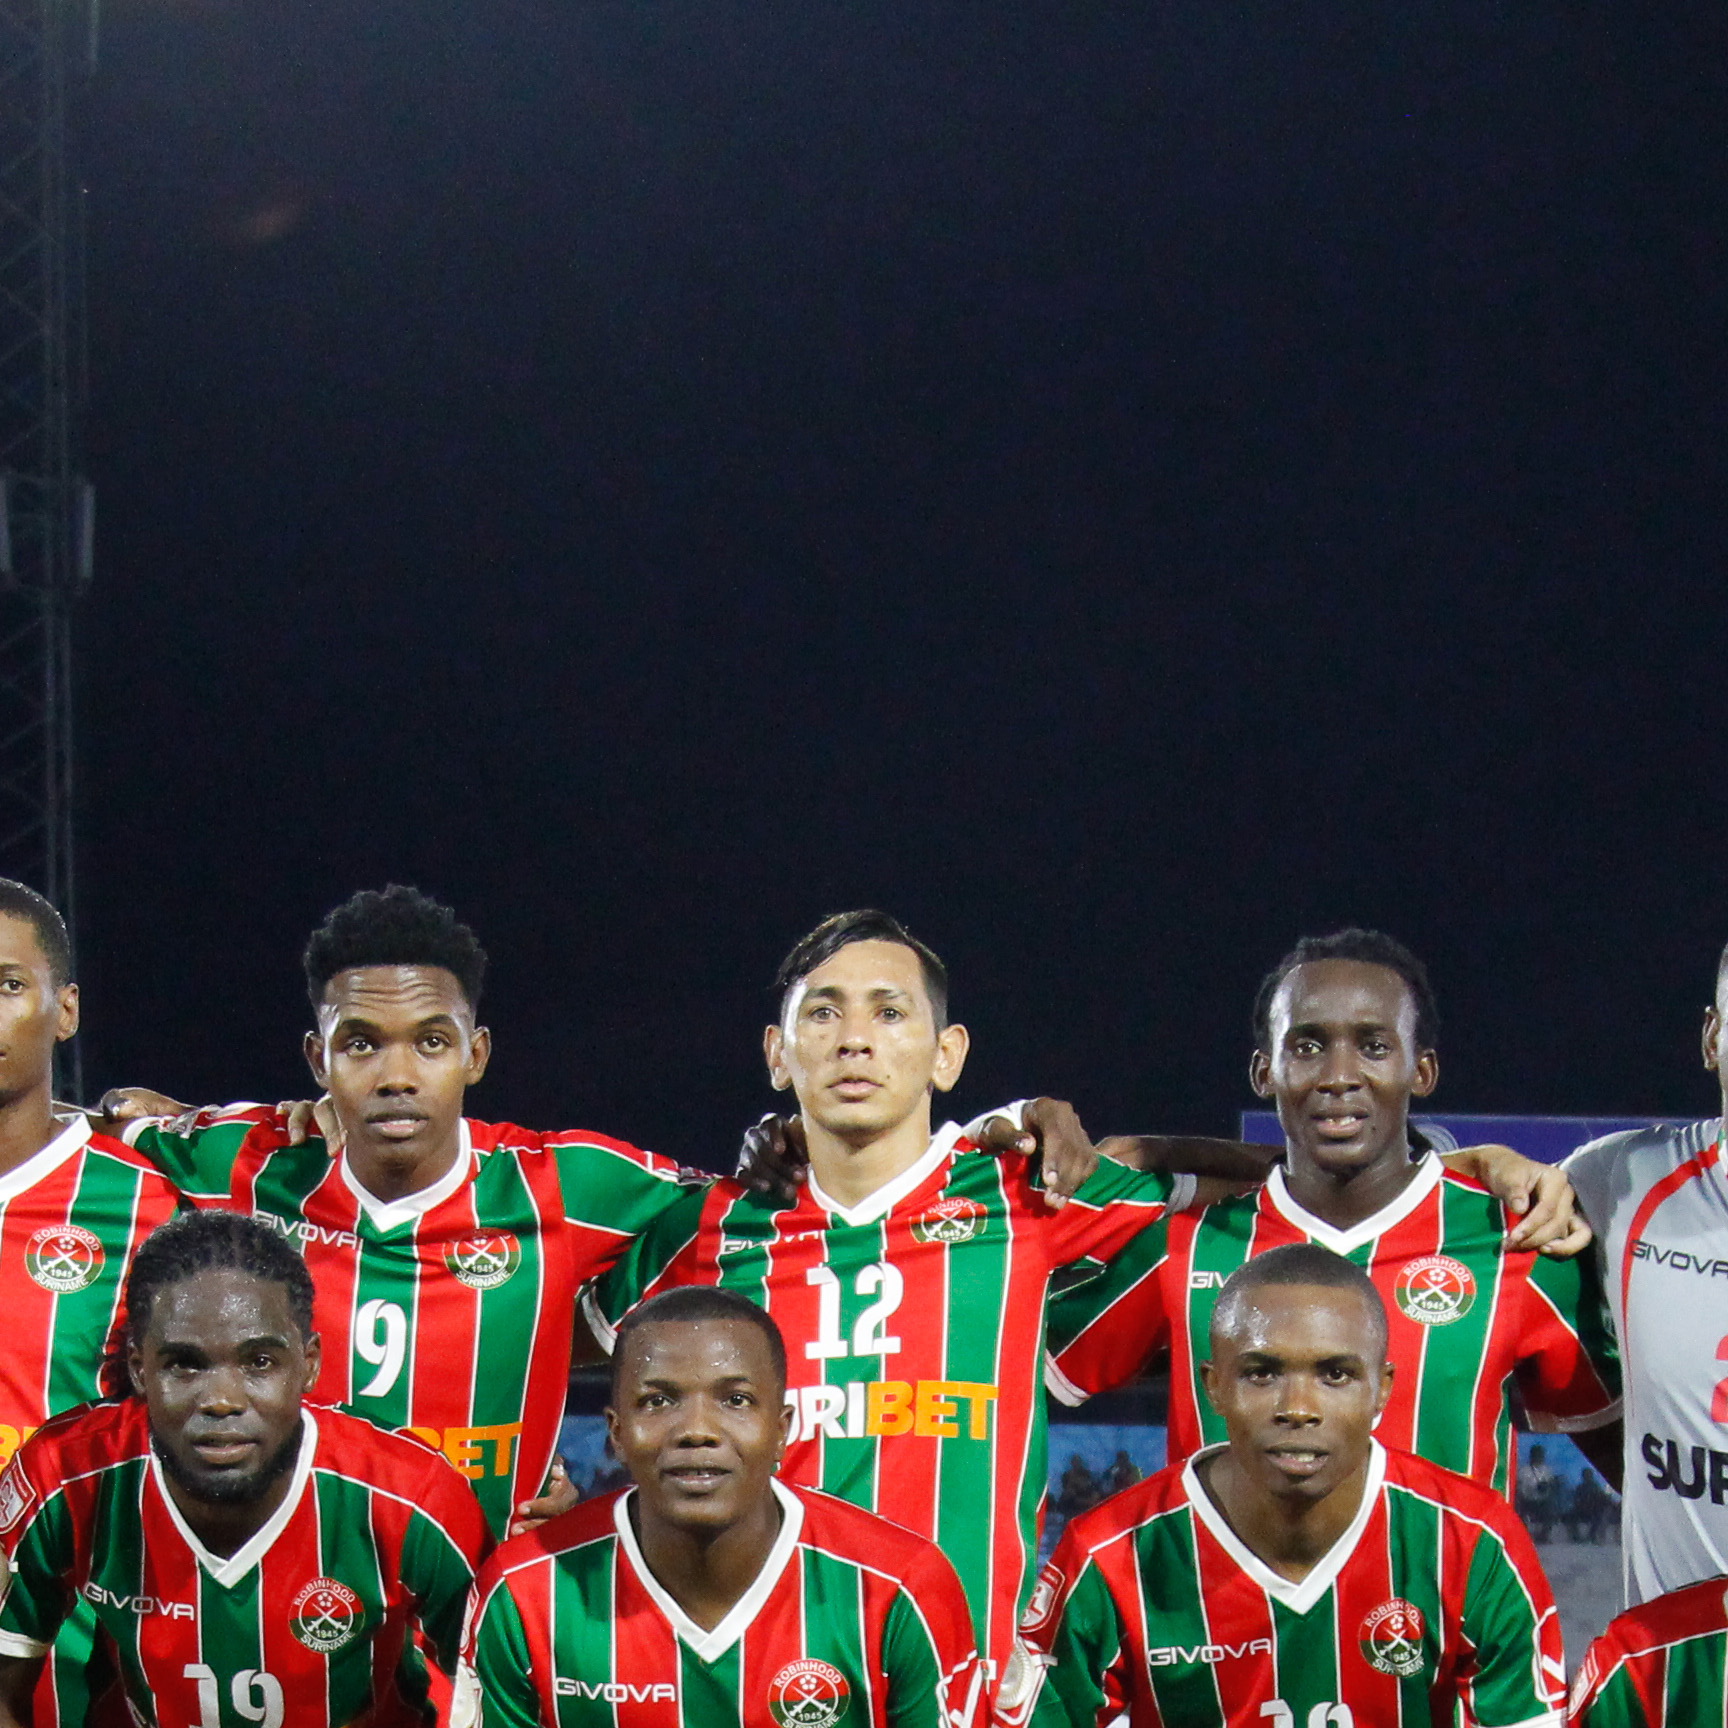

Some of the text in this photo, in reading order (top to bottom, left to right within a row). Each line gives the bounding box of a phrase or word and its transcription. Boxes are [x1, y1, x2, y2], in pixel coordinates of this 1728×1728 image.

[33, 1227, 100, 1251] ROBINHOOD
[33, 1271, 90, 1292] SURINAME
[455, 1270, 511, 1287] SURINAME
[1403, 1256, 1471, 1283] ROBINHOOD
[804, 1261, 904, 1360] 12
[1403, 1303, 1462, 1324] SURINAME
[355, 1298, 408, 1398] 9
[83, 1582, 195, 1622] GIVOVA
[294, 1579, 356, 1606] ROBINHOOD
[1147, 1637, 1273, 1667] GIVOVA
[773, 1661, 842, 1688] ROBINHOOD
[554, 1676, 676, 1703] GIVOVA
[798, 1711, 823, 1721] 1945
